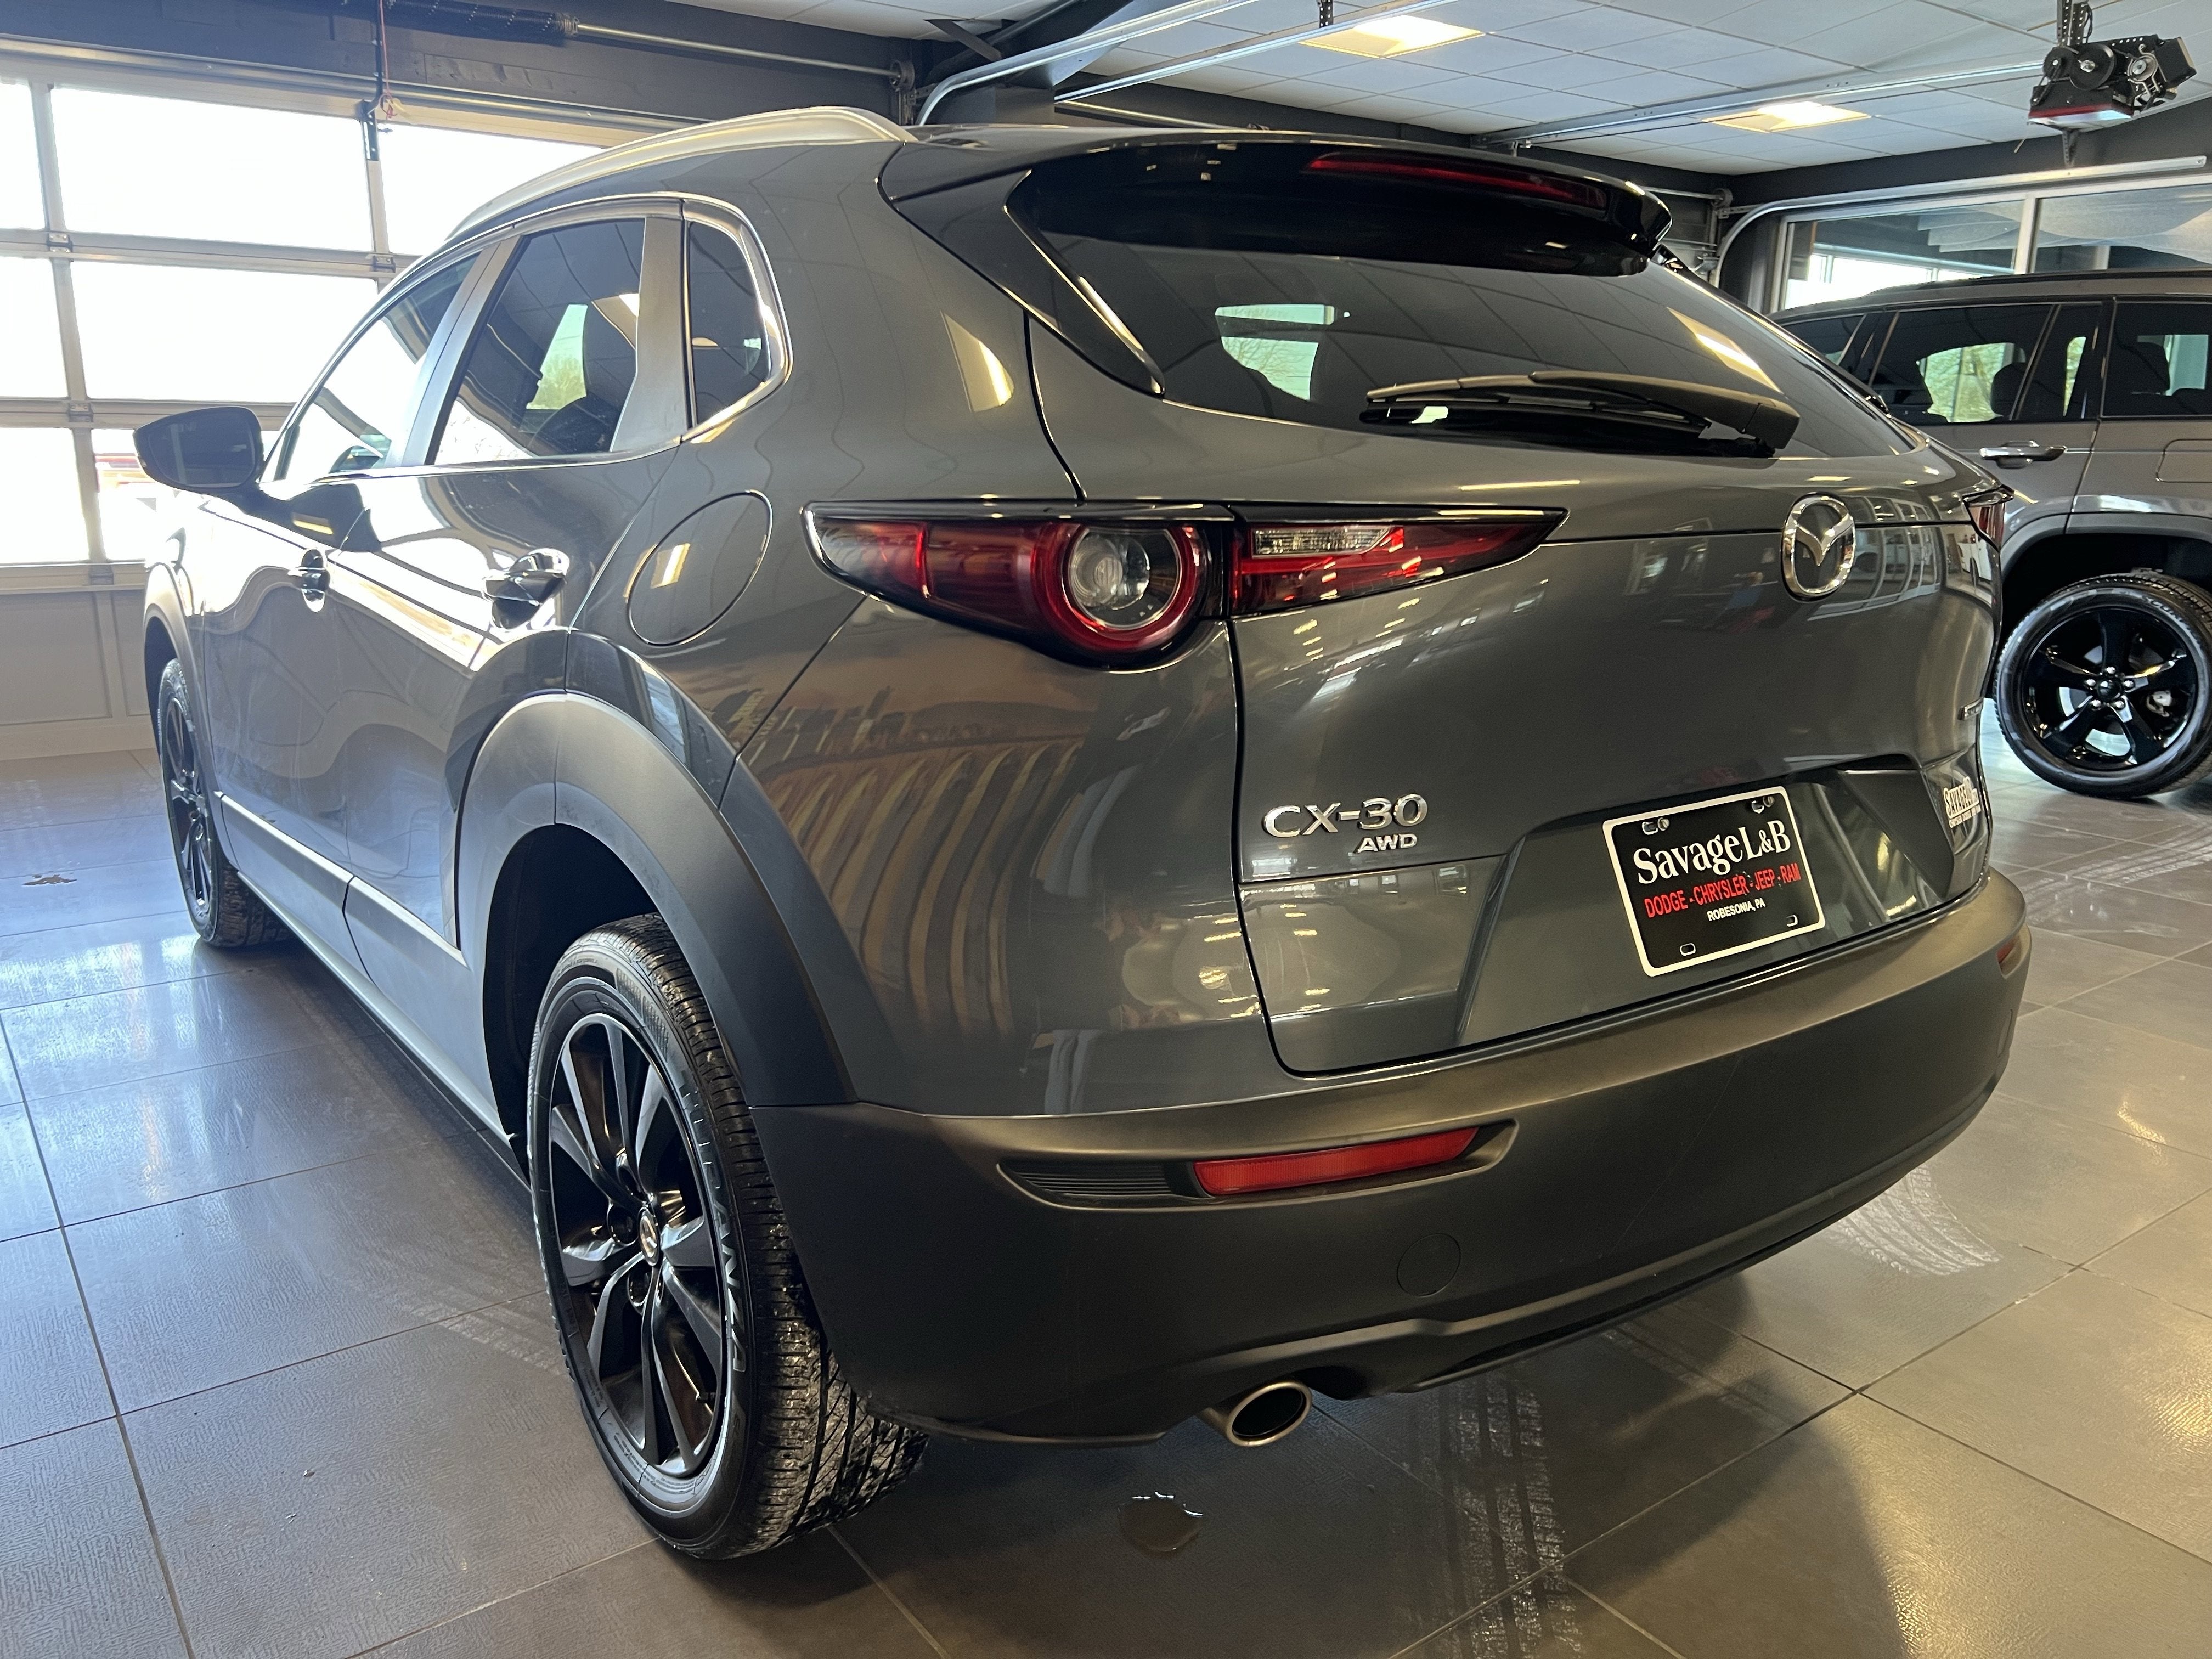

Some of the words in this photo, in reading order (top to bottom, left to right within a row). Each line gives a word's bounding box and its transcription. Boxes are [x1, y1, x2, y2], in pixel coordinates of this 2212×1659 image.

[1262, 793, 1427, 838] CX-30
[1354, 833, 1417, 854] AWD
[1644, 890, 1688, 918] DODGE
[1694, 875, 1749, 906] CHRYSLER
[1754, 868, 1775, 891] JEEP
[1780, 862, 1801, 884] RAM
[1755, 898, 1766, 909] PA
